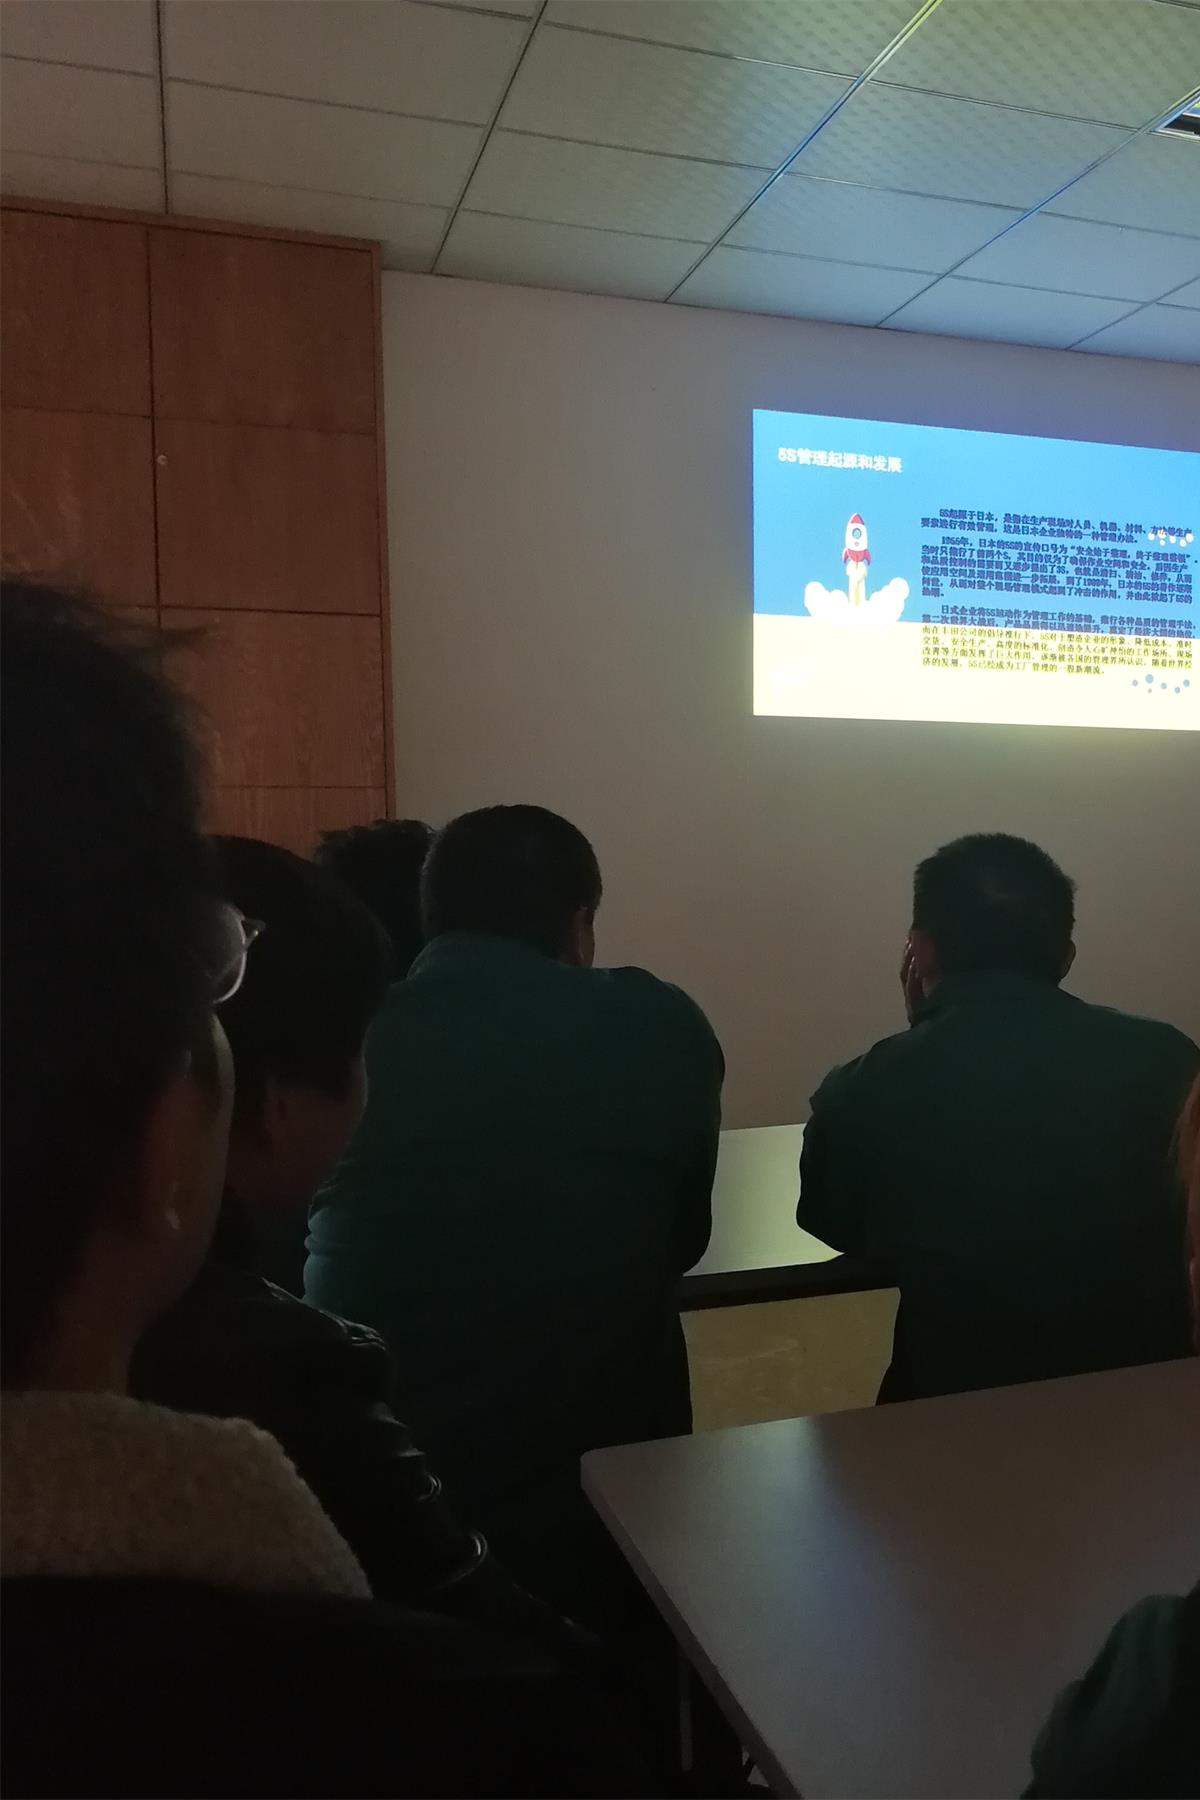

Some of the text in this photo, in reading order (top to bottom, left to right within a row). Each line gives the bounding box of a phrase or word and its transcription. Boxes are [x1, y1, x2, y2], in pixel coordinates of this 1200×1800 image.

[778, 447, 903, 473] 5S管理起源和发展
